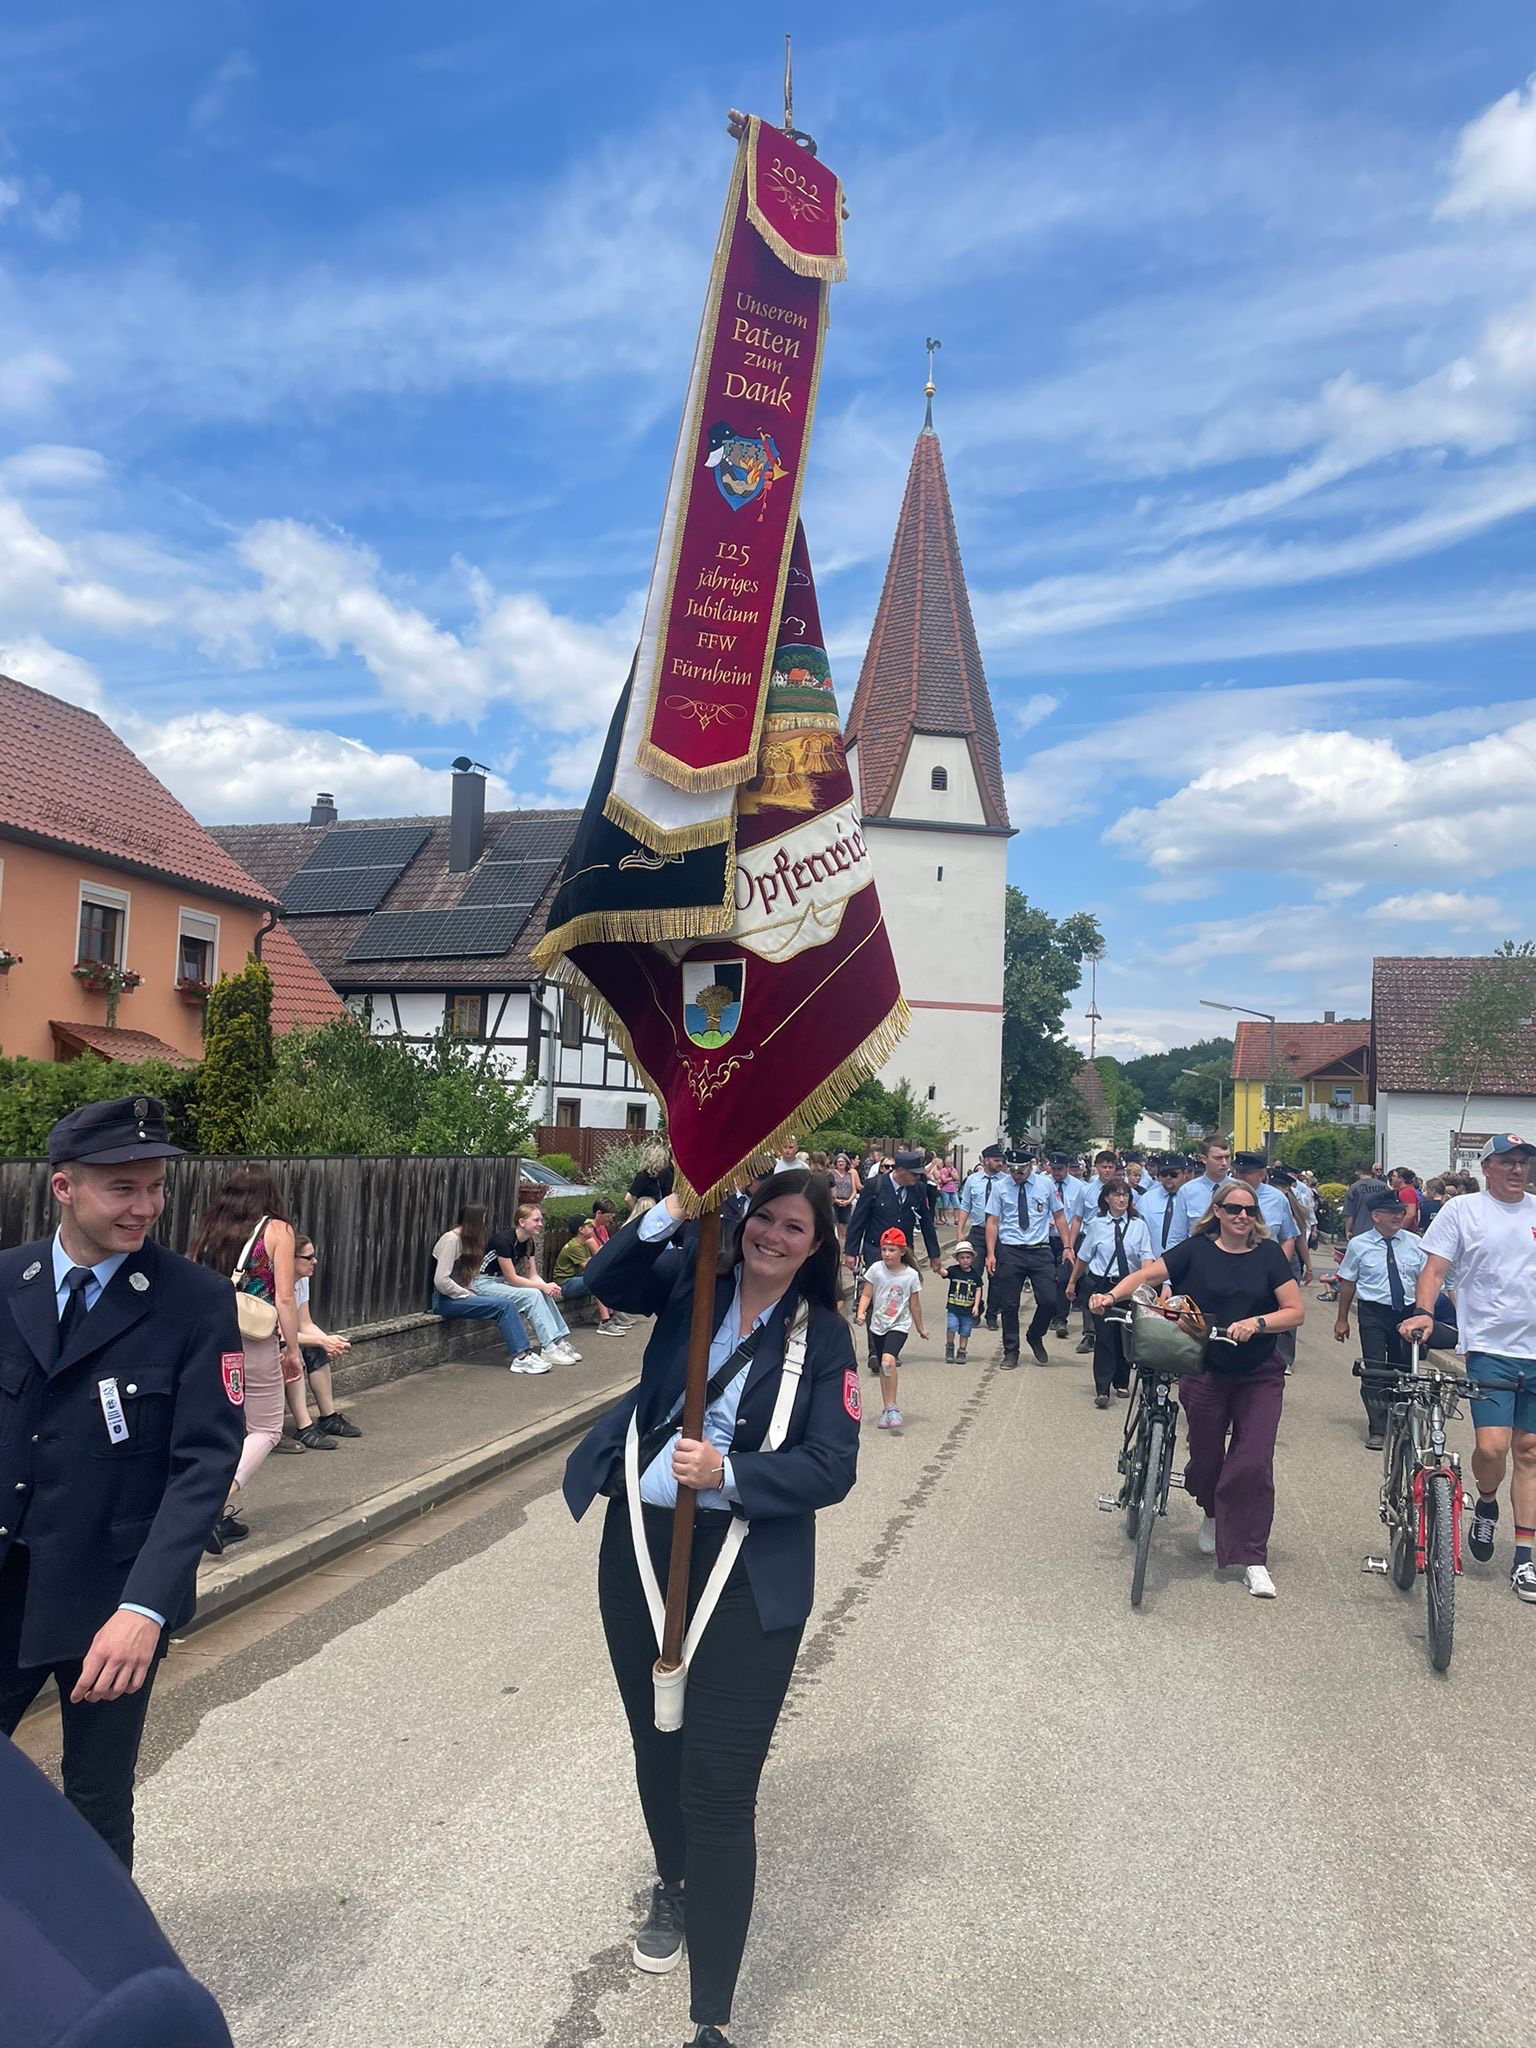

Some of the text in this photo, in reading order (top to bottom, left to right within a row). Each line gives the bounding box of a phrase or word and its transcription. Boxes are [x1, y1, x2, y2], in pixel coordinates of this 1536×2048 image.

[771, 158, 821, 203] 2022
[736, 291, 808, 329] Unserem
[731, 317, 801, 359] Paten
[743, 351, 783, 374] zum
[722, 372, 792, 413] Dank
[715, 542, 751, 567] 125
[695, 566, 759, 597] jähriges
[684, 598, 759, 624] Jubiläum
[696, 632, 738, 652] FFW
[670, 658, 753, 686] Fürnheim
